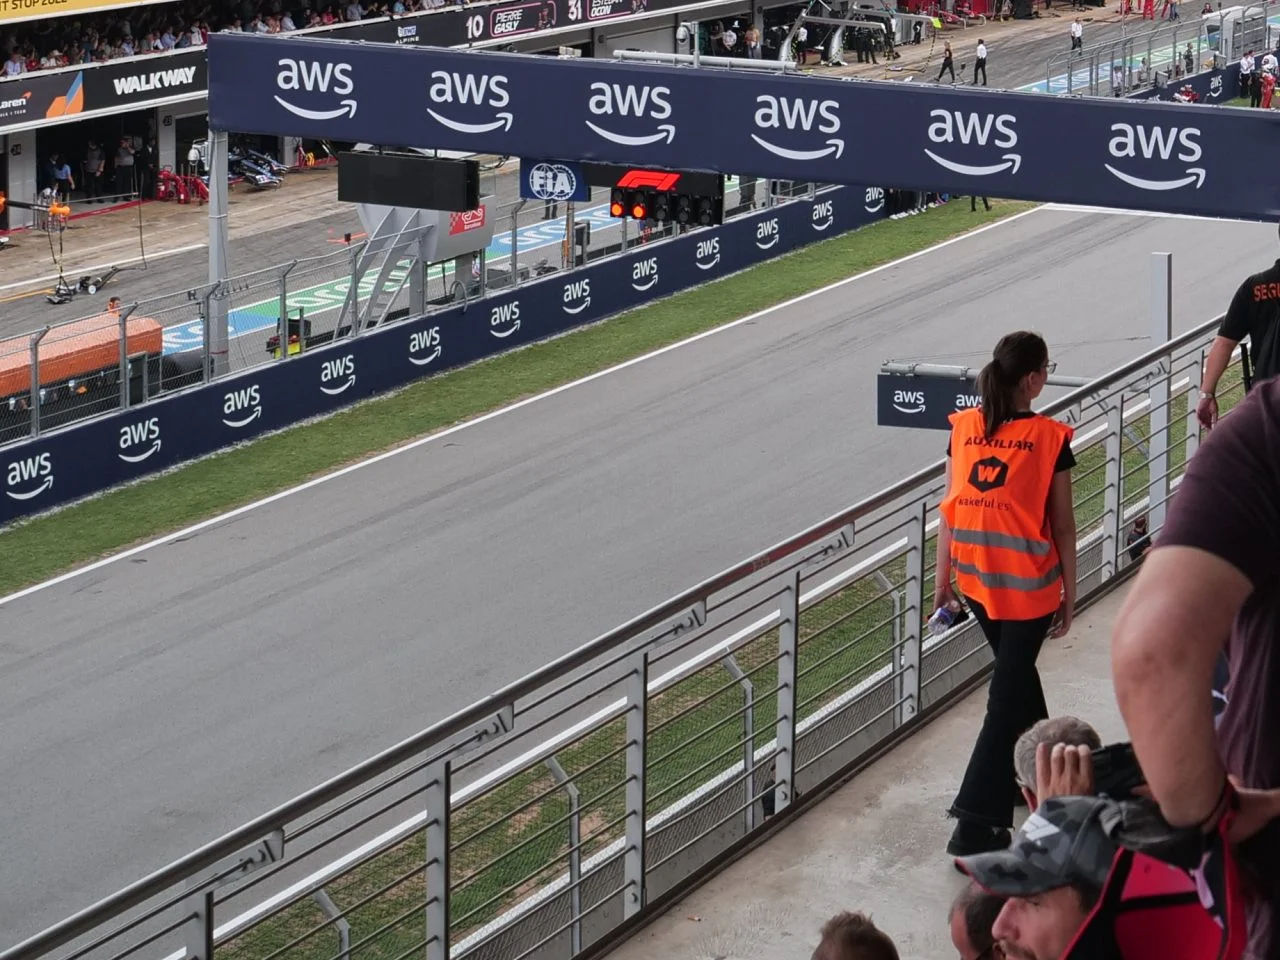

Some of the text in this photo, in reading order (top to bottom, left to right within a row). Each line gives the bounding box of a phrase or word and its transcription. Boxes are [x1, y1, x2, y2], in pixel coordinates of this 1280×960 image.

[495, 9, 524, 24] PIERRE
[590, 4, 612, 17] OCON
[465, 14, 484, 39] 10
[494, 20, 519, 35] GASLY
[113, 65, 197, 96] WALKWAY
[277, 57, 354, 96] aws
[429, 69, 511, 108] aws
[588, 81, 673, 120] aws
[754, 94, 842, 135] aws
[928, 108, 1018, 149] aws
[1108, 122, 1203, 163] aws
[533, 172, 572, 193] FIA
[865, 186, 885, 203] aws
[812, 199, 833, 221] aws
[756, 217, 779, 238] aws
[696, 236, 720, 259] aws
[632, 257, 658, 280] aws
[563, 278, 591, 303] aws
[490, 300, 520, 326] aws
[409, 325, 440, 353] aws
[320, 354, 355, 382] aws
[223, 383, 260, 414] aws
[893, 390, 925, 404] aws
[119, 416, 160, 449] aws
[964, 436, 1035, 452] AUXILIAR
[7, 451, 52, 487] aws
[977, 464, 1002, 482] W
